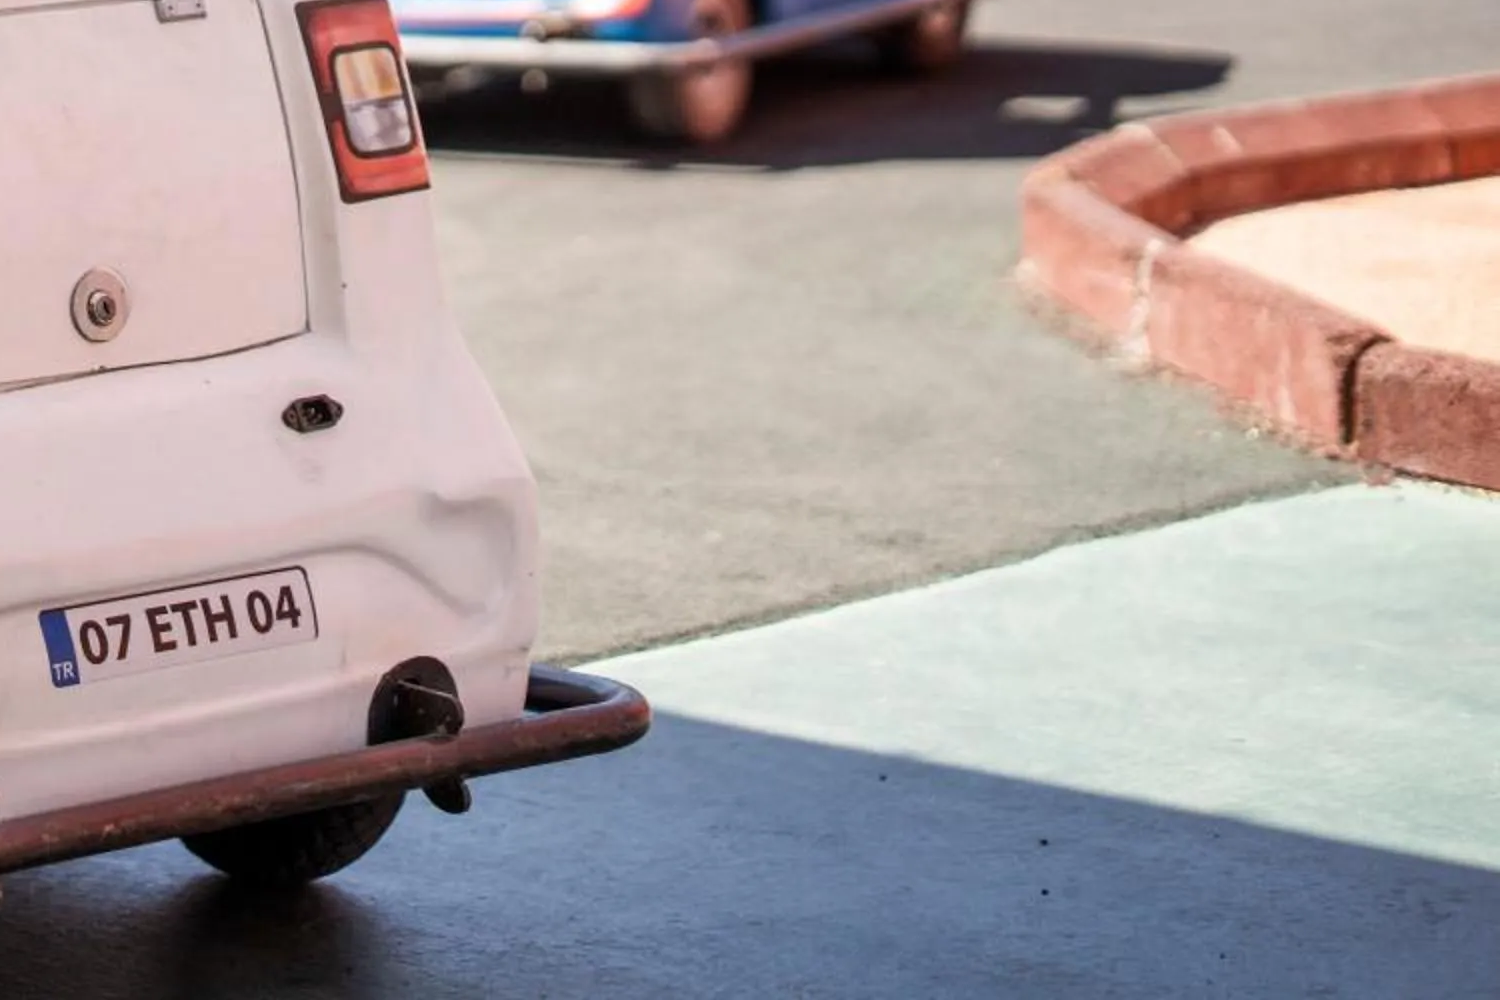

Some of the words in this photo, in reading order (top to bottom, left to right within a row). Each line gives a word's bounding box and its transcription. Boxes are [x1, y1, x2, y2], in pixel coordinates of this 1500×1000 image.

[79, 614, 131, 665] 07
[145, 594, 238, 653] ETH
[247, 585, 301, 634] 04
[53, 661, 75, 681] TR
